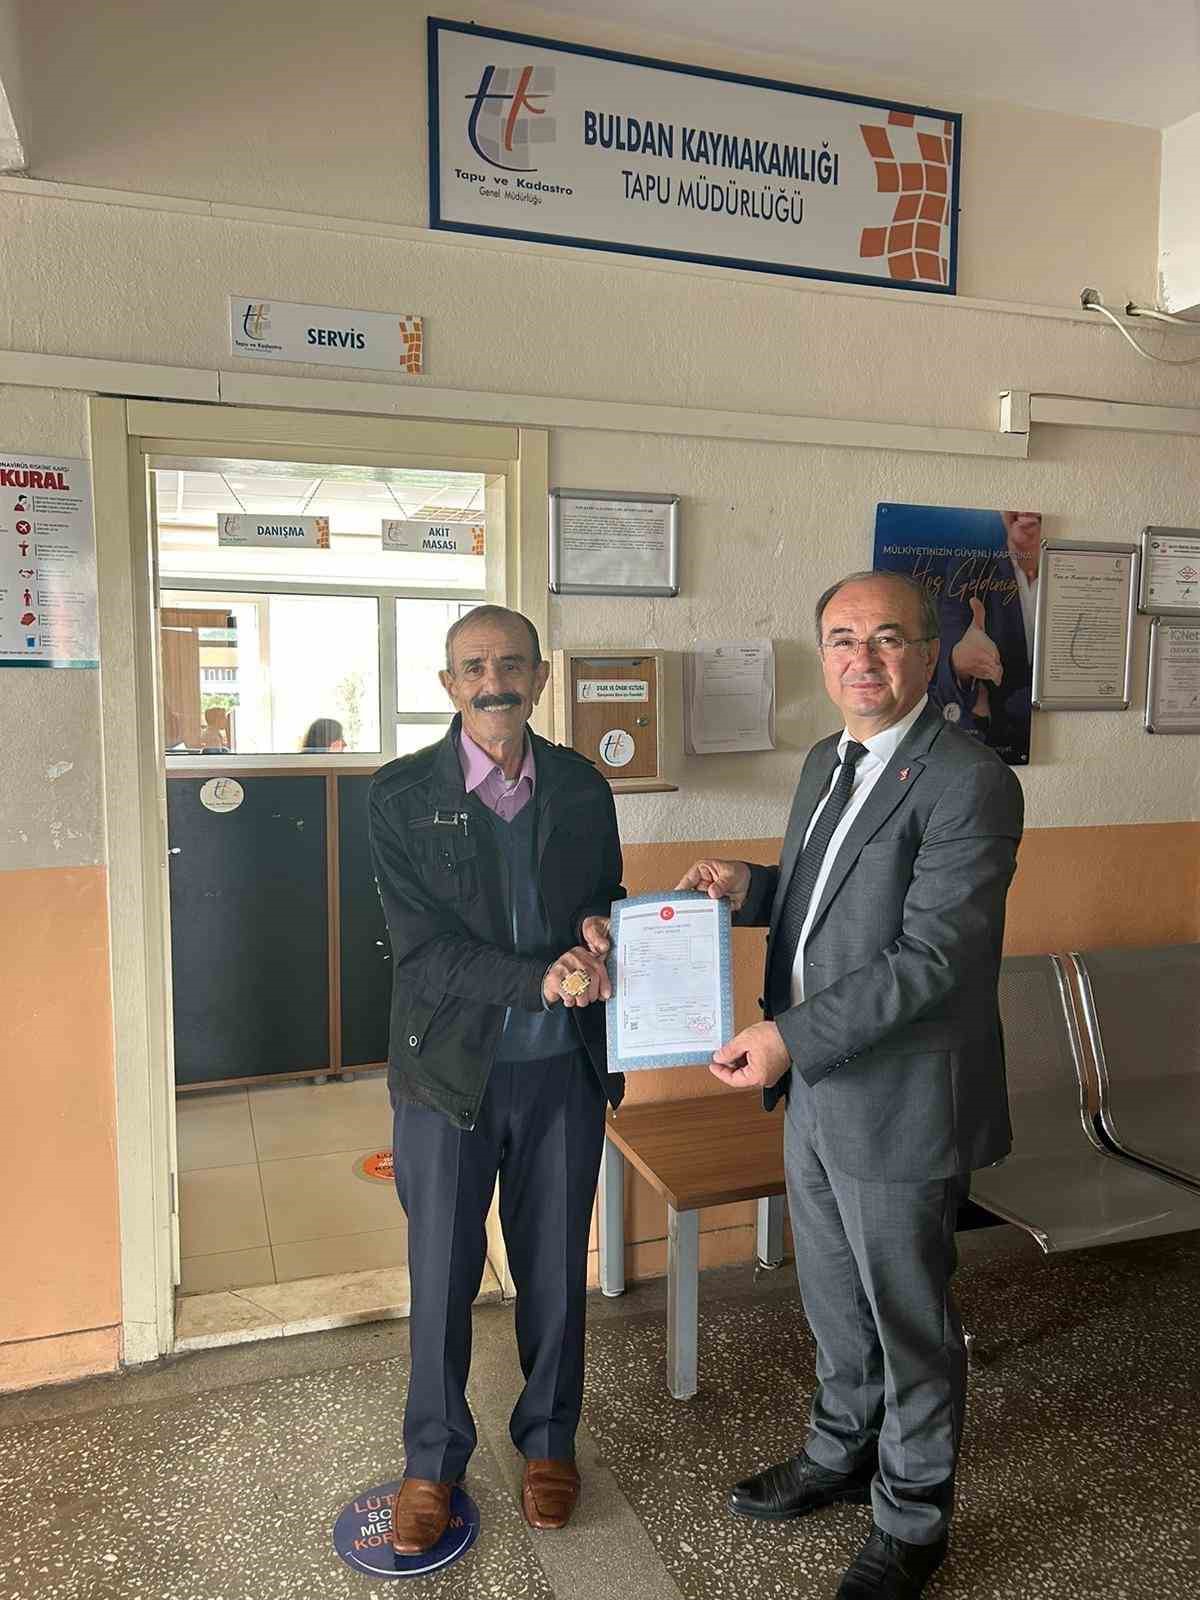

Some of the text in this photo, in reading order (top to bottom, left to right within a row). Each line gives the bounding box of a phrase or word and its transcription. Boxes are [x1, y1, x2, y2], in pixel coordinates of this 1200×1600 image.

[584, 110, 839, 186] BULDAN KAYMAKAMLIĞI
[454, 168, 573, 196] Tapu ve Kadastro
[479, 186, 501, 198] Genel
[622, 170, 803, 224] TAPU MÜDÜRLÜĞÜ
[307, 328, 365, 349] SERVİS
[0, 469, 70, 491] KURAL
[257, 526, 304, 538] DANIŞMA
[428, 526, 449, 538] AKİT
[422, 540, 457, 550] MASASI
